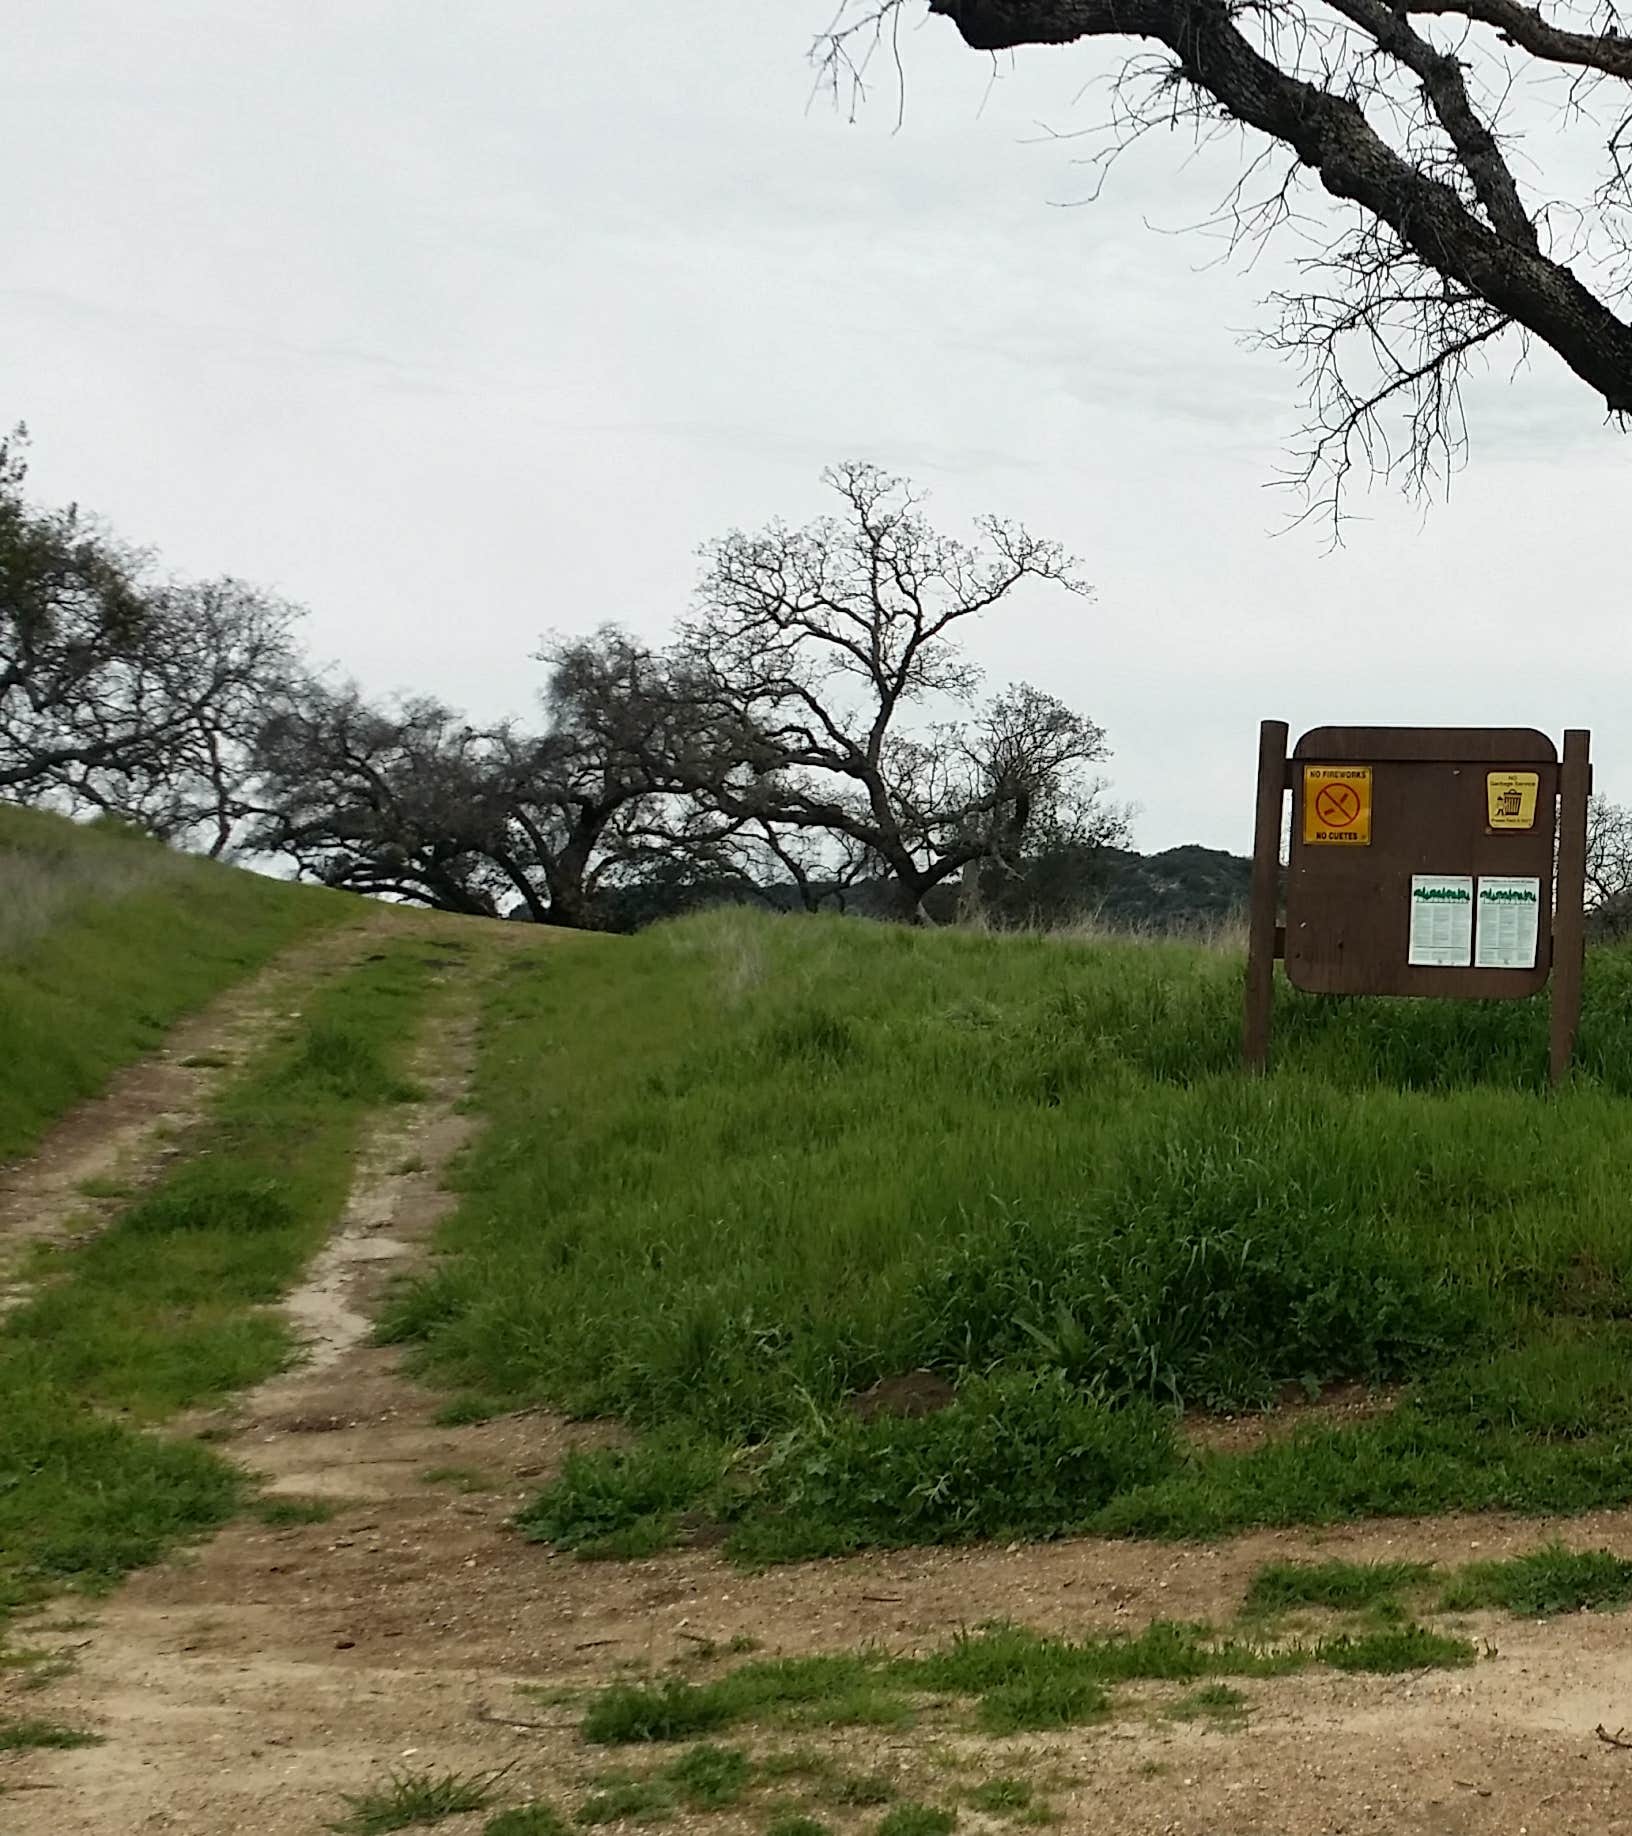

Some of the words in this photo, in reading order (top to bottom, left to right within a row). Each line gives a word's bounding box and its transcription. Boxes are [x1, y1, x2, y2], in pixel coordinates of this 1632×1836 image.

[1323, 771, 1366, 779] FIREWORKS
[1316, 832, 1326, 840] NO
[1329, 832, 1358, 840] CUETES
